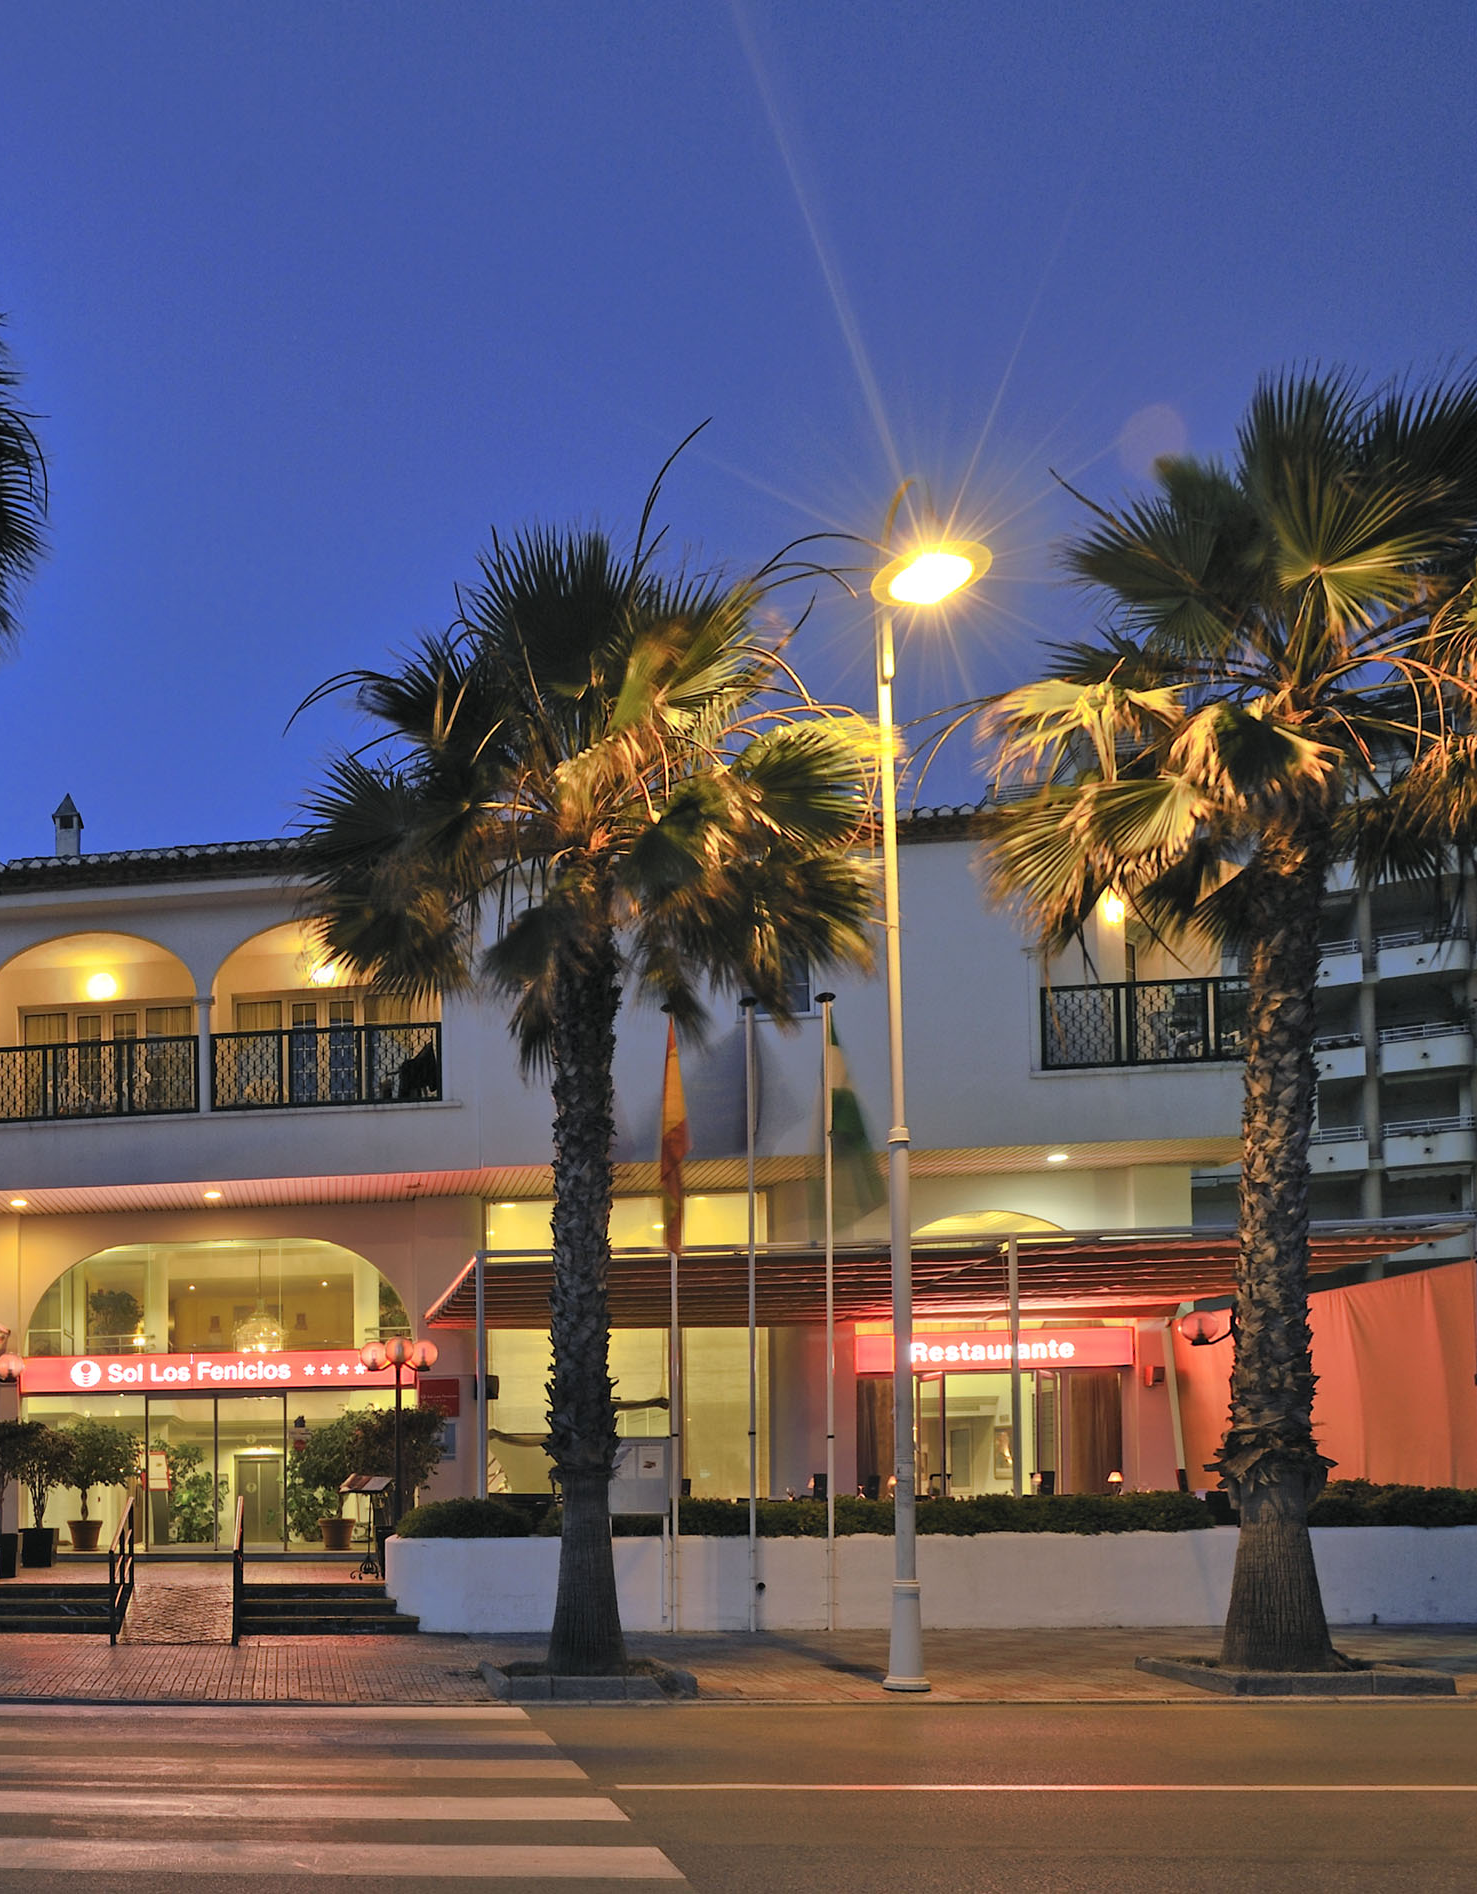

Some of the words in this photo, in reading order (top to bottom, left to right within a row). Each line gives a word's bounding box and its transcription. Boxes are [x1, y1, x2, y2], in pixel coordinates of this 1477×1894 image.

[911, 1339, 1075, 1363] Restaurante
[108, 1363, 143, 1383] Sol
[151, 1363, 190, 1382] Los
[197, 1361, 291, 1381] Fenicios
